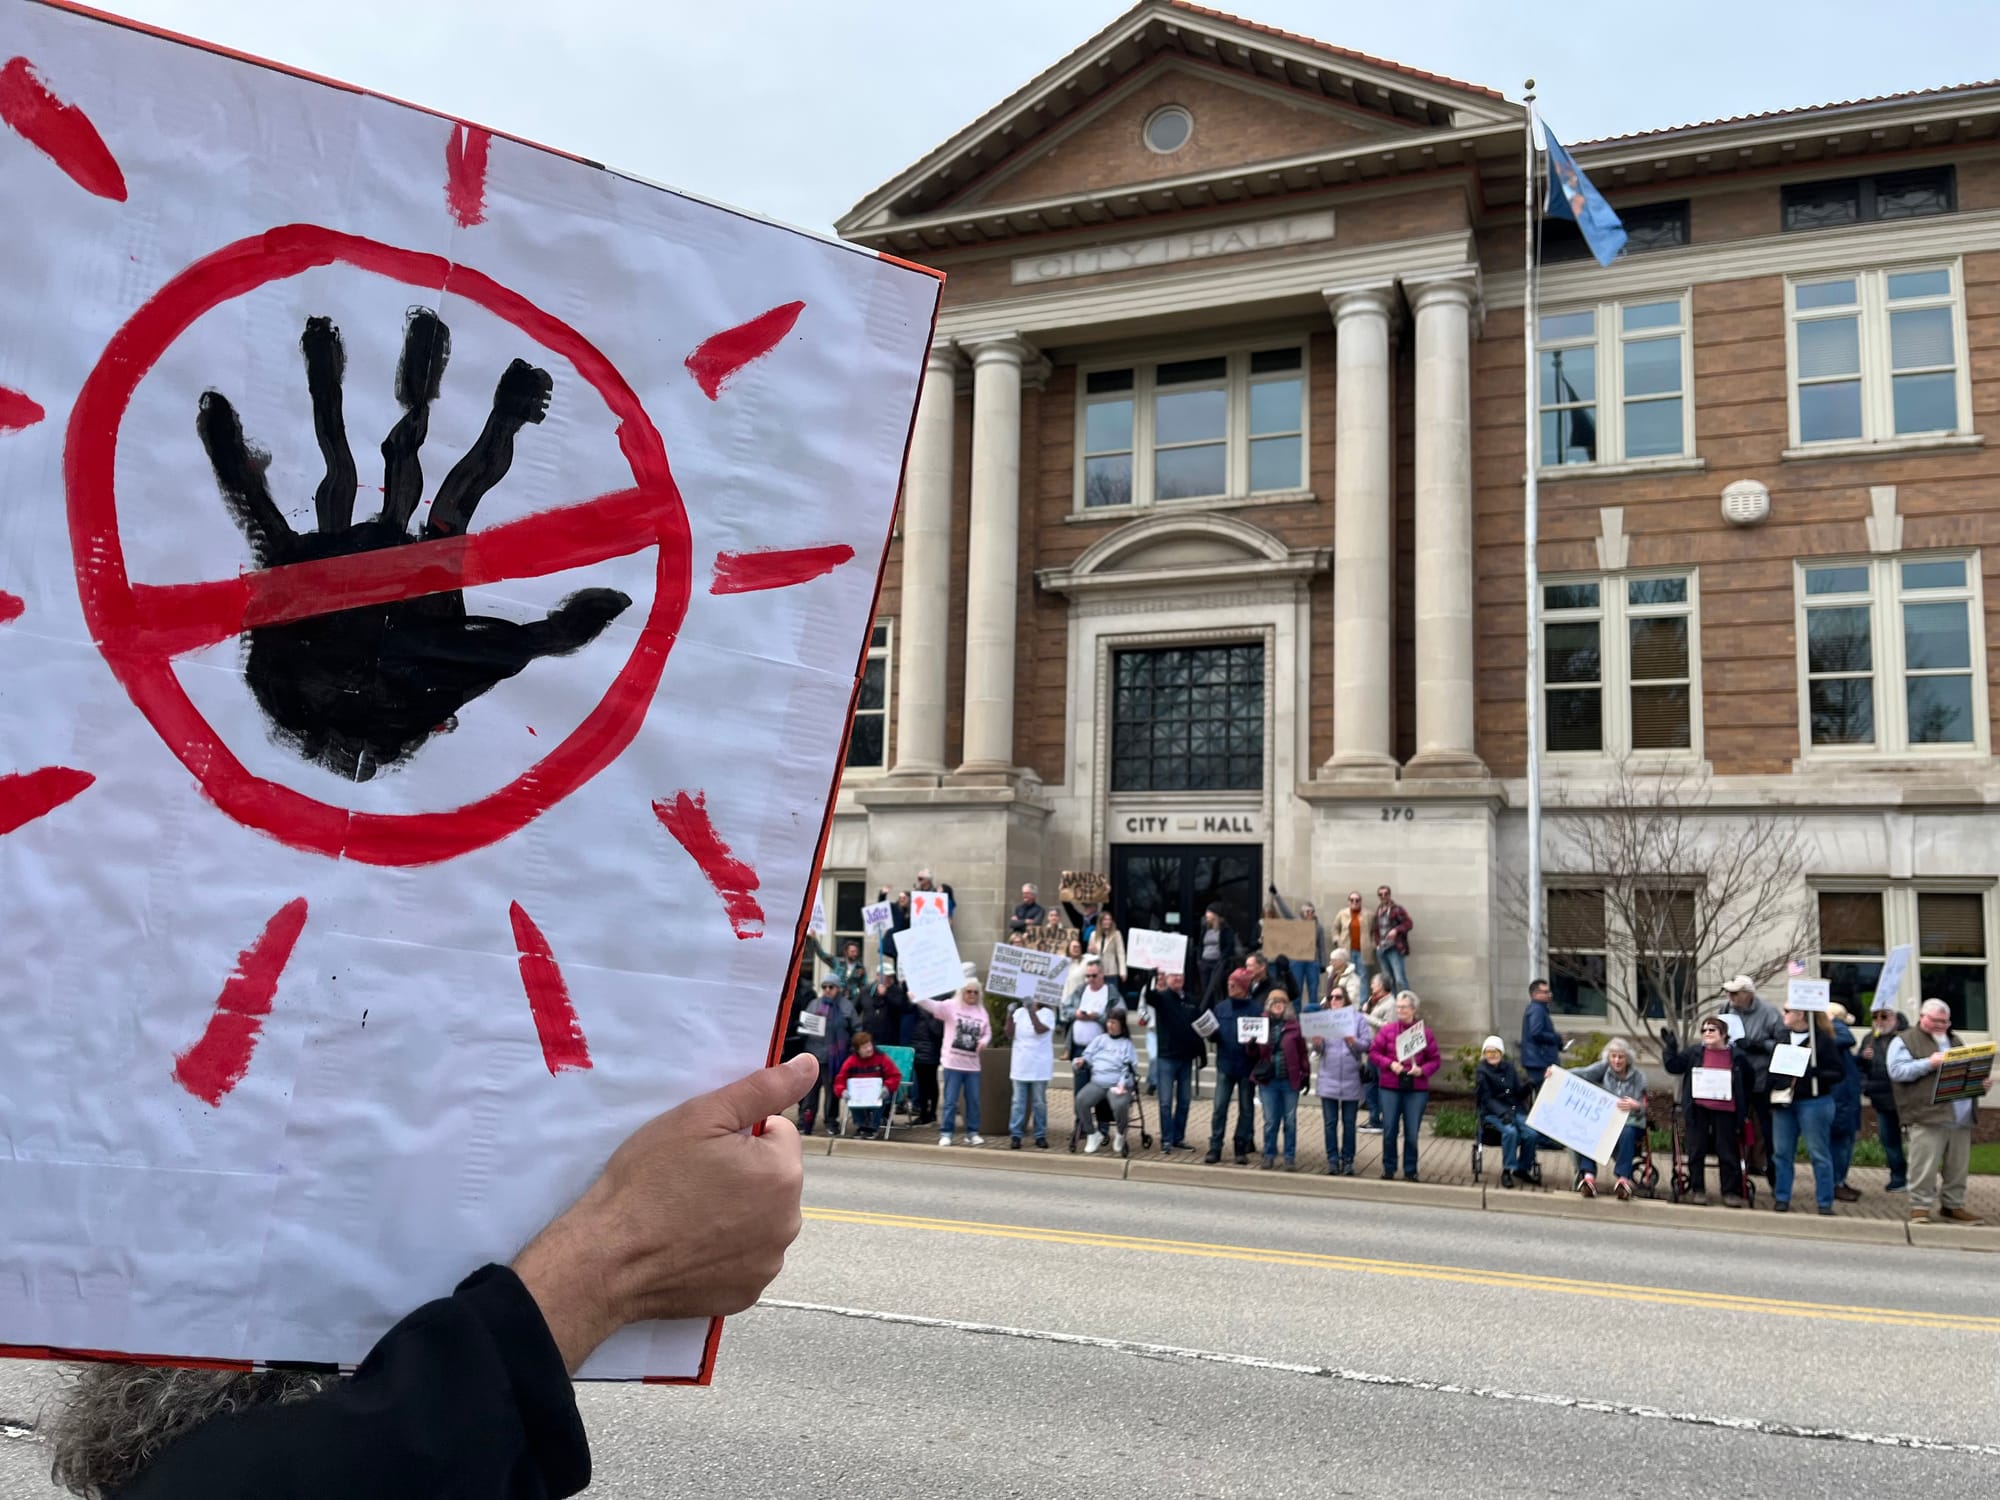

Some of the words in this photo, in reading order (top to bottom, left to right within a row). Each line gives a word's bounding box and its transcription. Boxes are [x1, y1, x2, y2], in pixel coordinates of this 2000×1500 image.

[1037, 244, 1146, 279] CITY
[1187, 221, 1308, 258] HALL
[1381, 806, 1414, 821] 270
[1126, 817, 1168, 833] CITY
[1203, 817, 1254, 833] HALL
[1062, 871, 1107, 888] HANDS
[1073, 885, 1096, 901] OFF
[1027, 926, 1079, 942] HANDS
[1564, 1095, 1601, 1122] HHS
